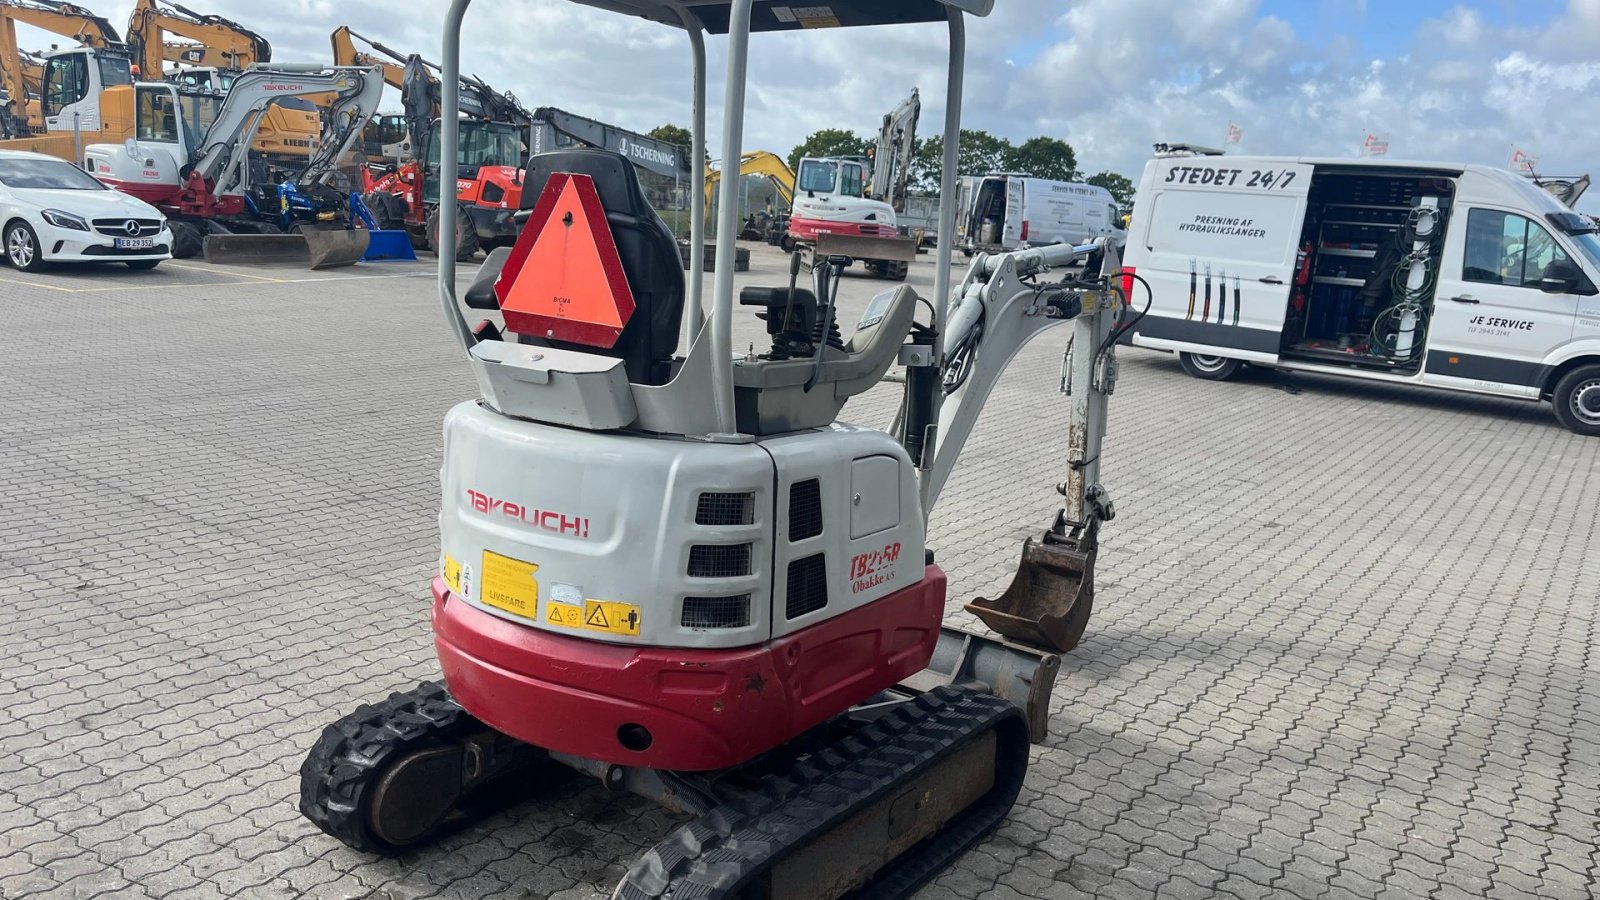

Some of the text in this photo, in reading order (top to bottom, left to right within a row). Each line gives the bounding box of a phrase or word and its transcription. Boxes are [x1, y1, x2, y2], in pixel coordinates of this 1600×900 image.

[189, 51, 200, 61] CAT
[630, 143, 675, 167] TSCHERNING
[1165, 166, 1297, 190] STEDET 24/7
[1195, 215, 1254, 227] PRESNING AF
[1179, 223, 1266, 238] HYDRAULIKSLANGER
[1470, 316, 1535, 331] JE SERVICE
[489, 590, 527, 610] LIVSFARE
